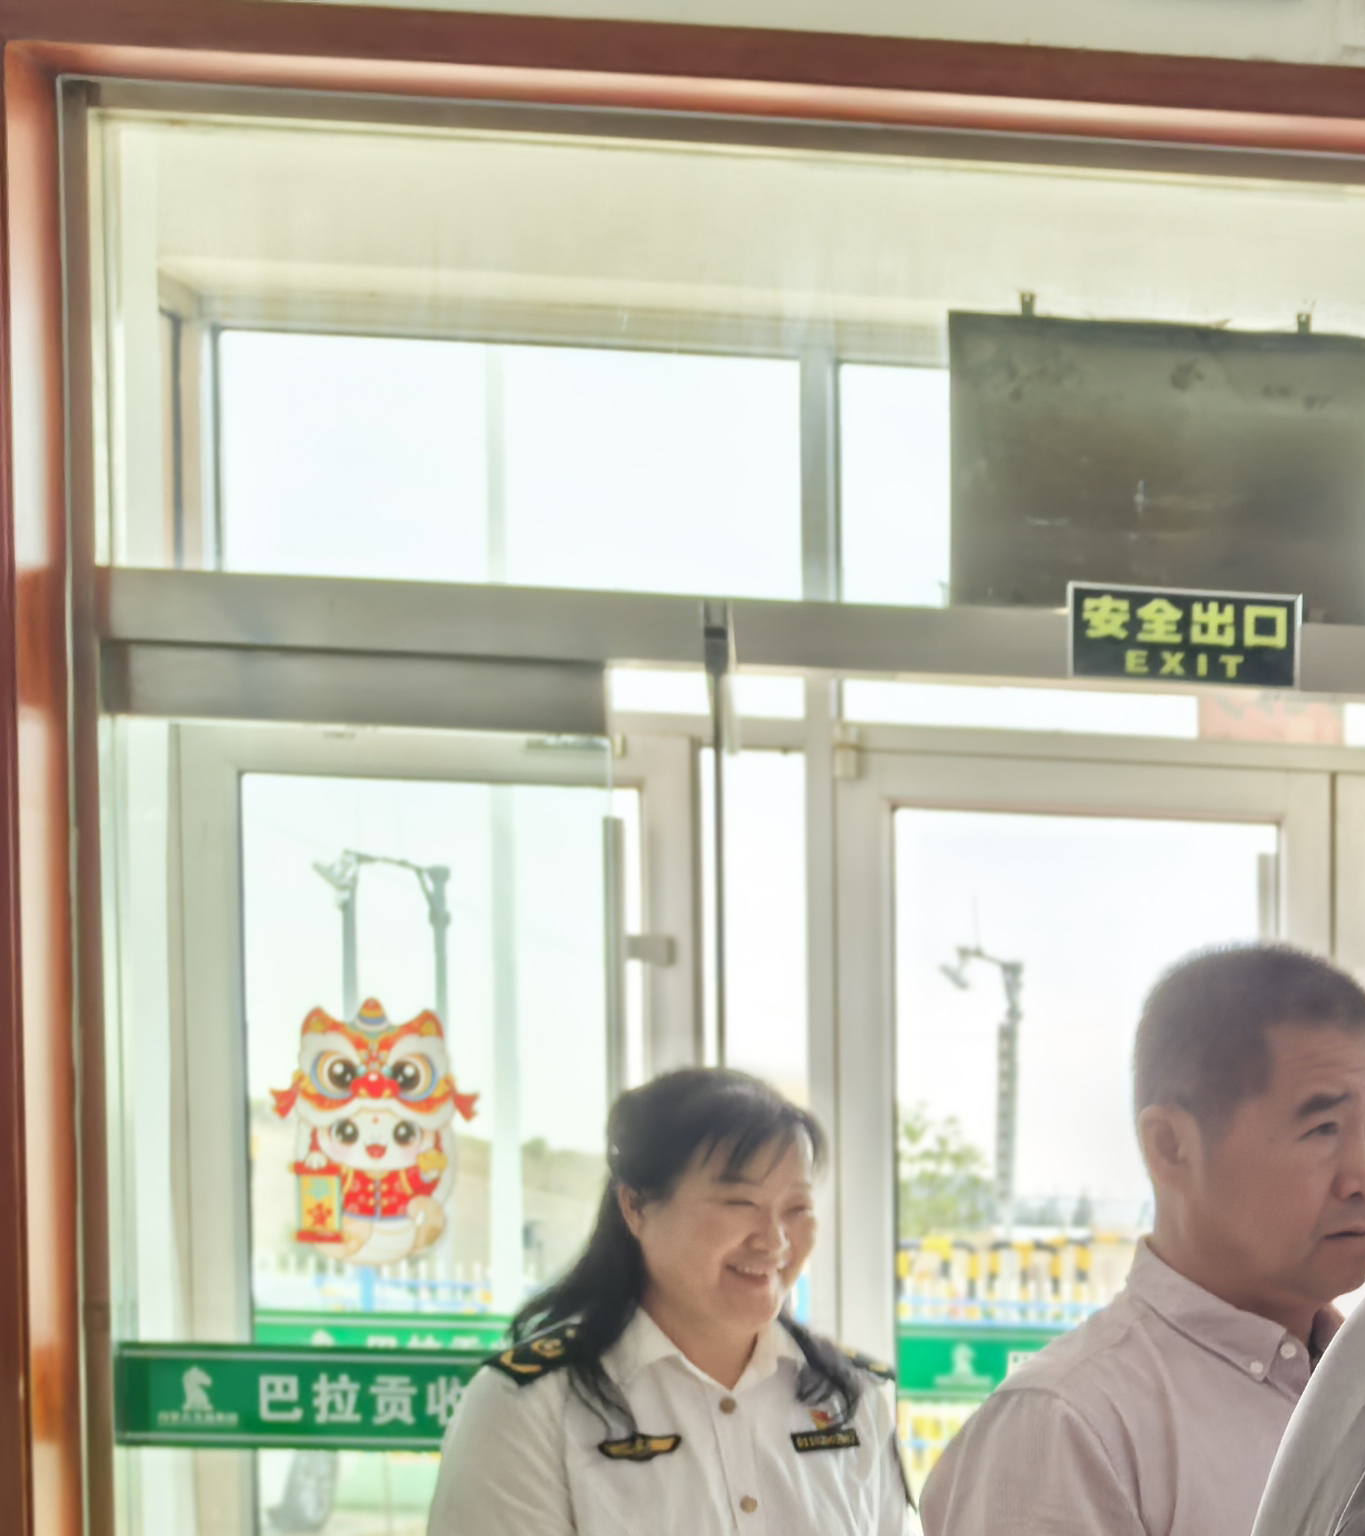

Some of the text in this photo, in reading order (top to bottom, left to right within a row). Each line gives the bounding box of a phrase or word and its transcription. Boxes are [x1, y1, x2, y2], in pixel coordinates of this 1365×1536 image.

[1082, 595, 1288, 649] 安全出口
[1124, 650, 1244, 678] EXIT
